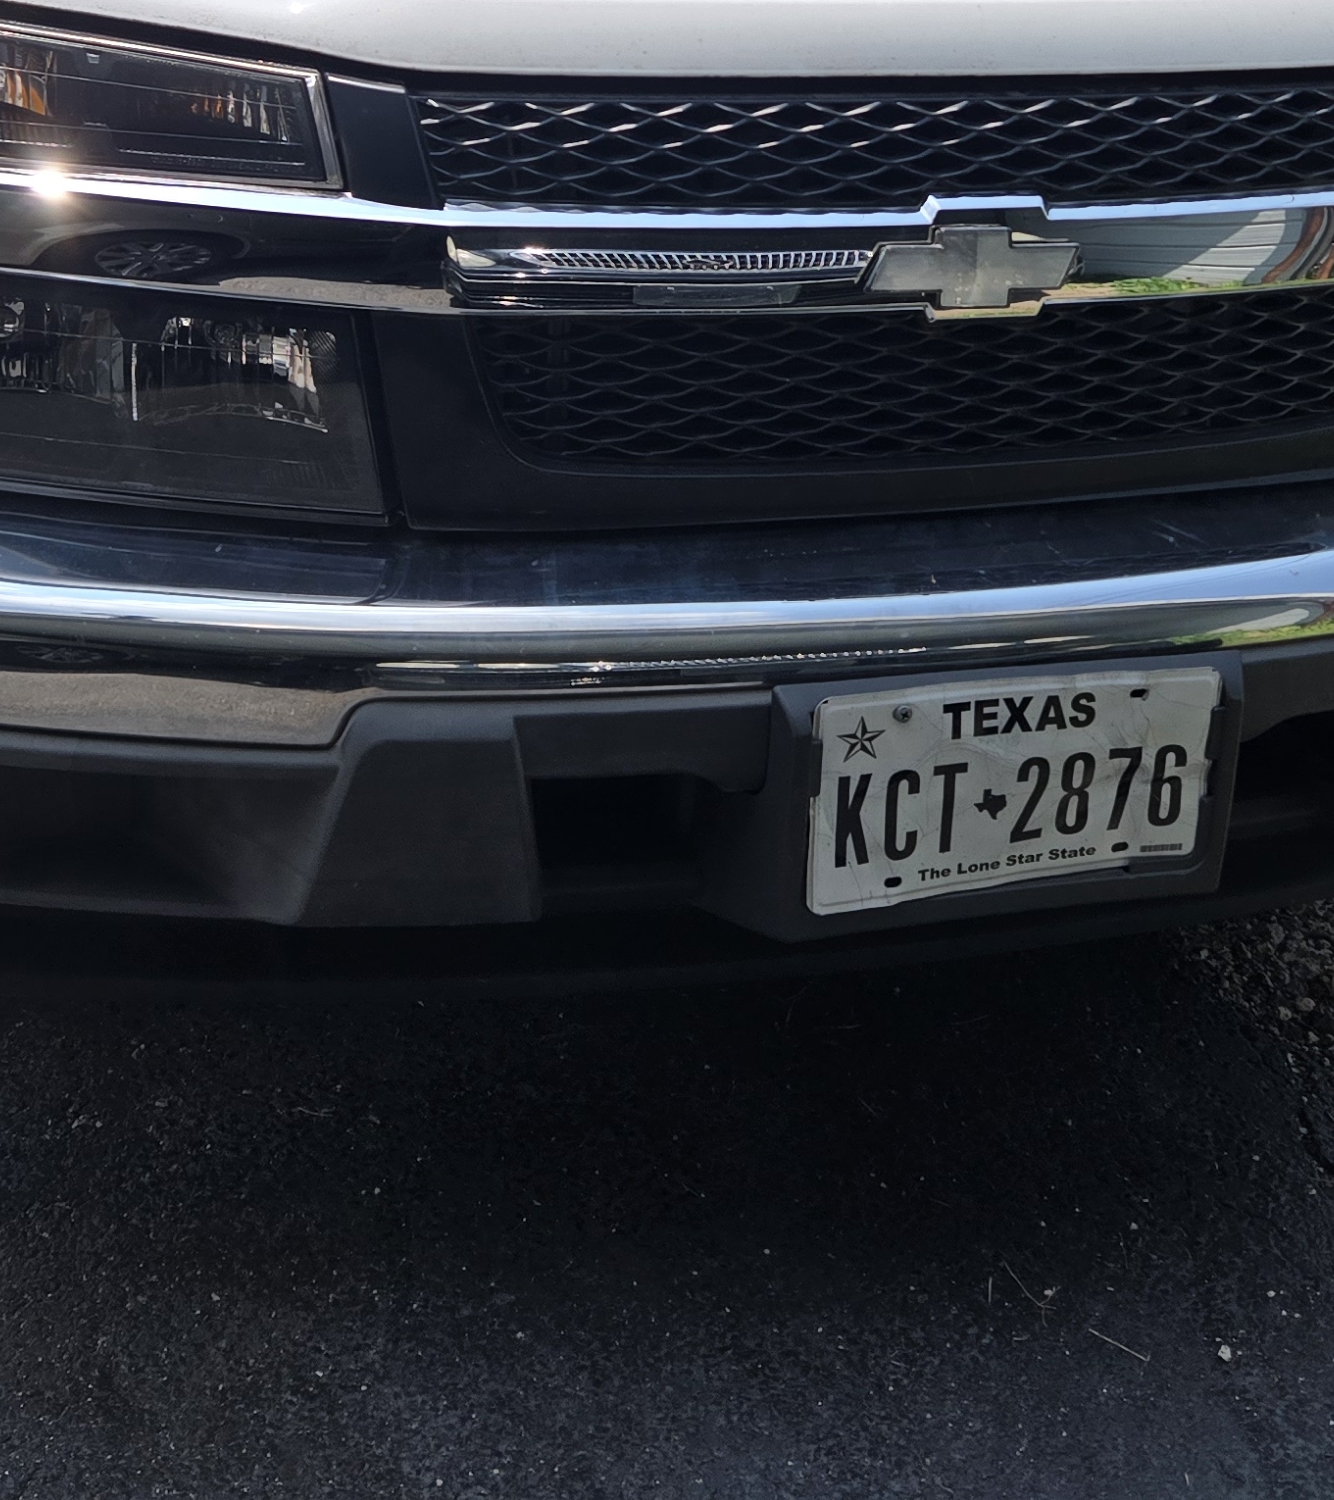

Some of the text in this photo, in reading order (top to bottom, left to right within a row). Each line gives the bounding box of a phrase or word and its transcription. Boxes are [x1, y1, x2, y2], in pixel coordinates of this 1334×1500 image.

[942, 691, 1096, 740] TEXAS
[834, 744, 1188, 868] KCT 2876
[917, 846, 1097, 882] The Lone Star State
